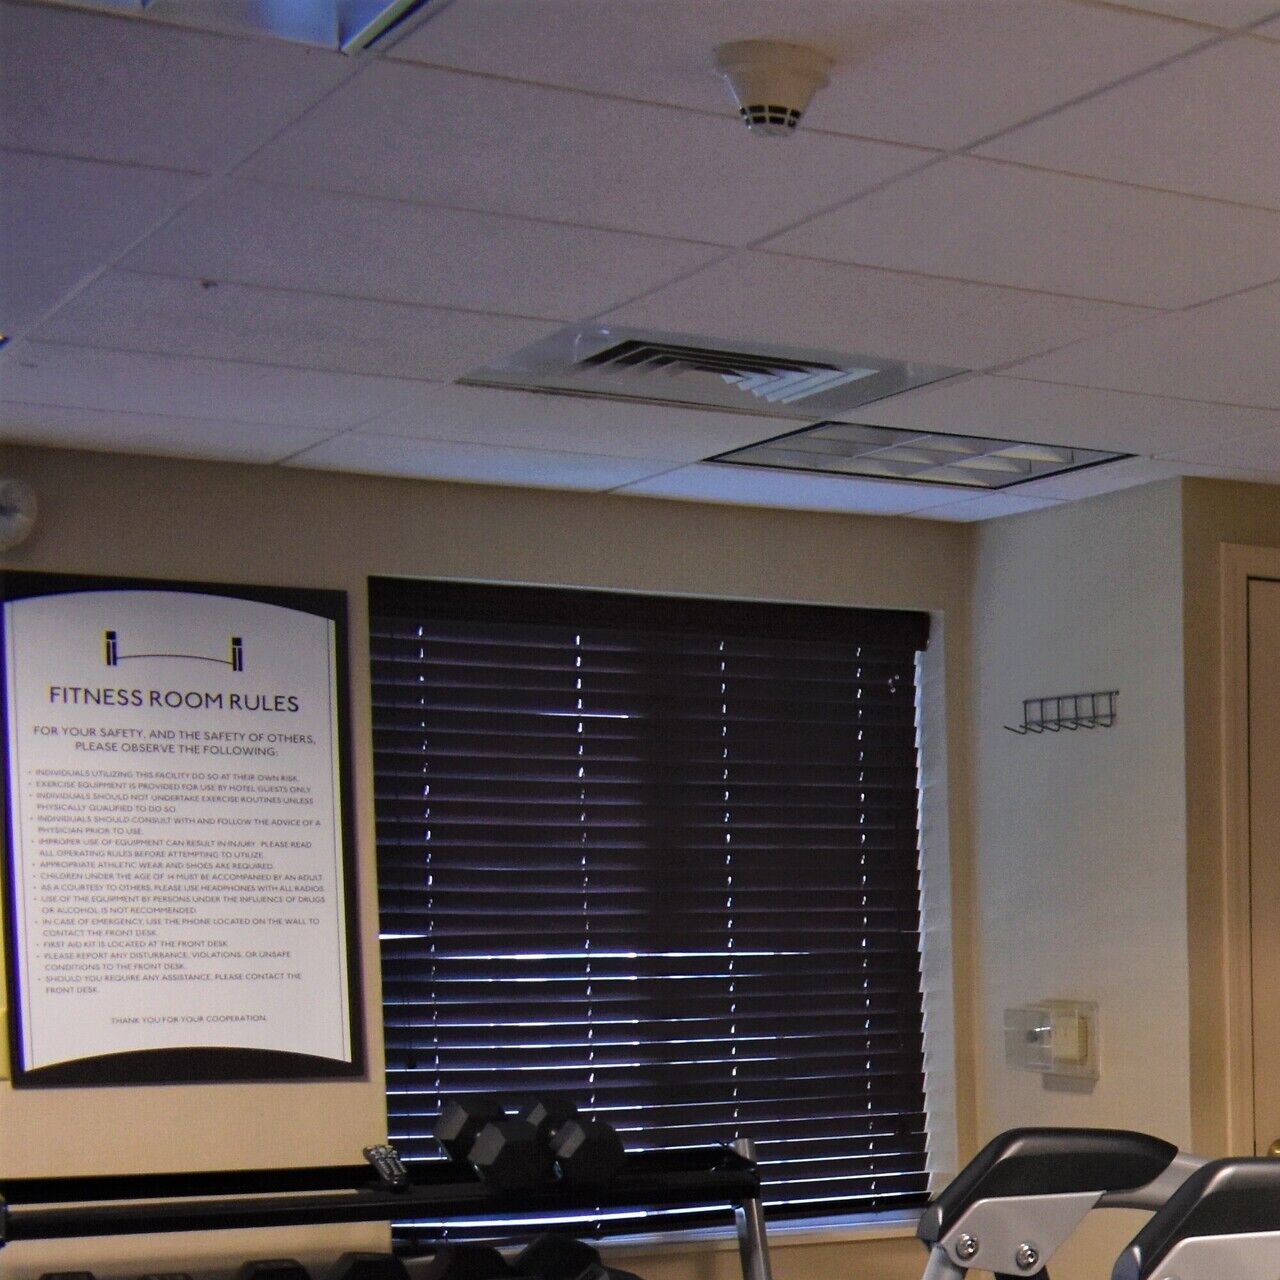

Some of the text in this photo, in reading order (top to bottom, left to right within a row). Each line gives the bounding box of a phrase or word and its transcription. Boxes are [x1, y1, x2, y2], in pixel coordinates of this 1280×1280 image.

[50, 686, 299, 712] FITNESS ROOM RULES
[34, 726, 58, 736] FOR
[62, 726, 97, 737] YOUR
[149, 730, 176, 740] AND
[179, 731, 201, 740] THE
[204, 731, 246, 741] SAFETY
[249, 733, 265, 742] OF
[75, 741, 118, 752] PLEASE
[121, 743, 176, 753] OBSERVE
[179, 744, 200, 754] THE
